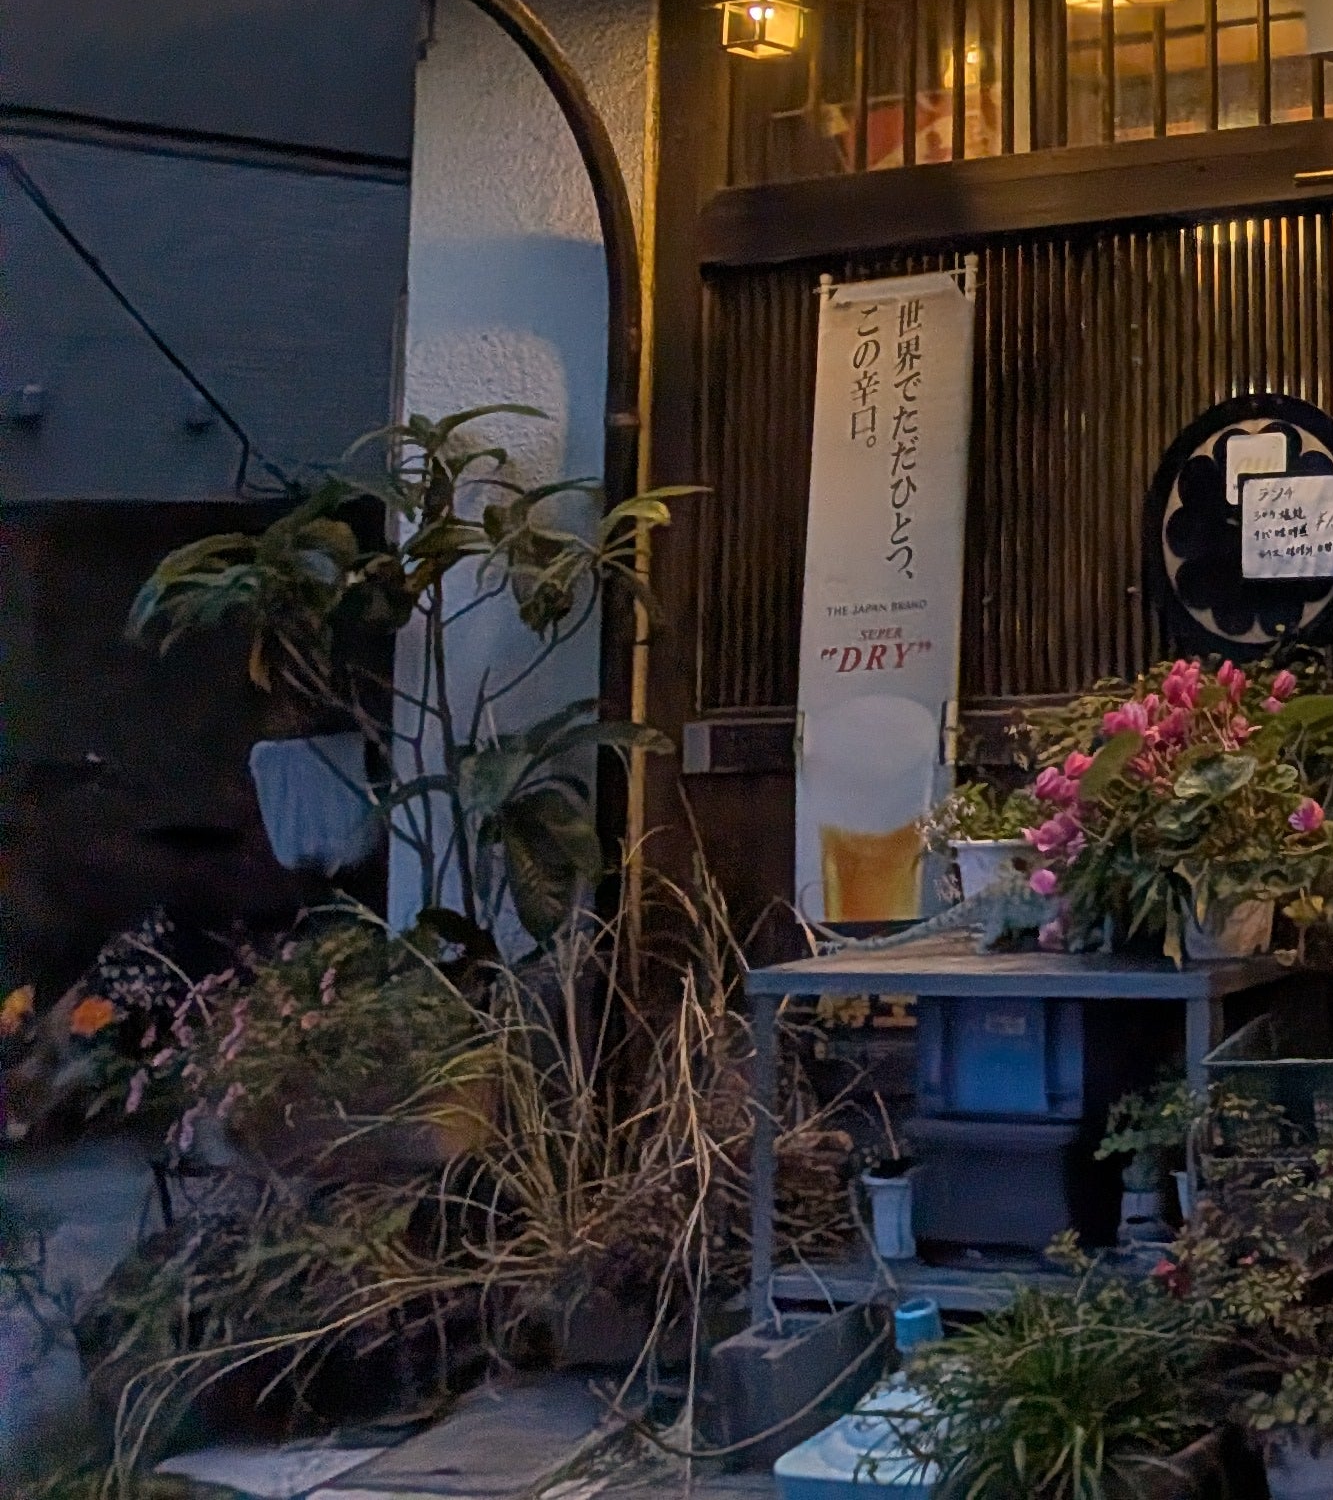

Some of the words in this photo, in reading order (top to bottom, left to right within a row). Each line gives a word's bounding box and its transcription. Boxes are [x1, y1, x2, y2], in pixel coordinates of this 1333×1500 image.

[850, 305, 881, 449] この辛口。
[826, 605, 848, 617] THE
[852, 602, 887, 615] JAPAN
